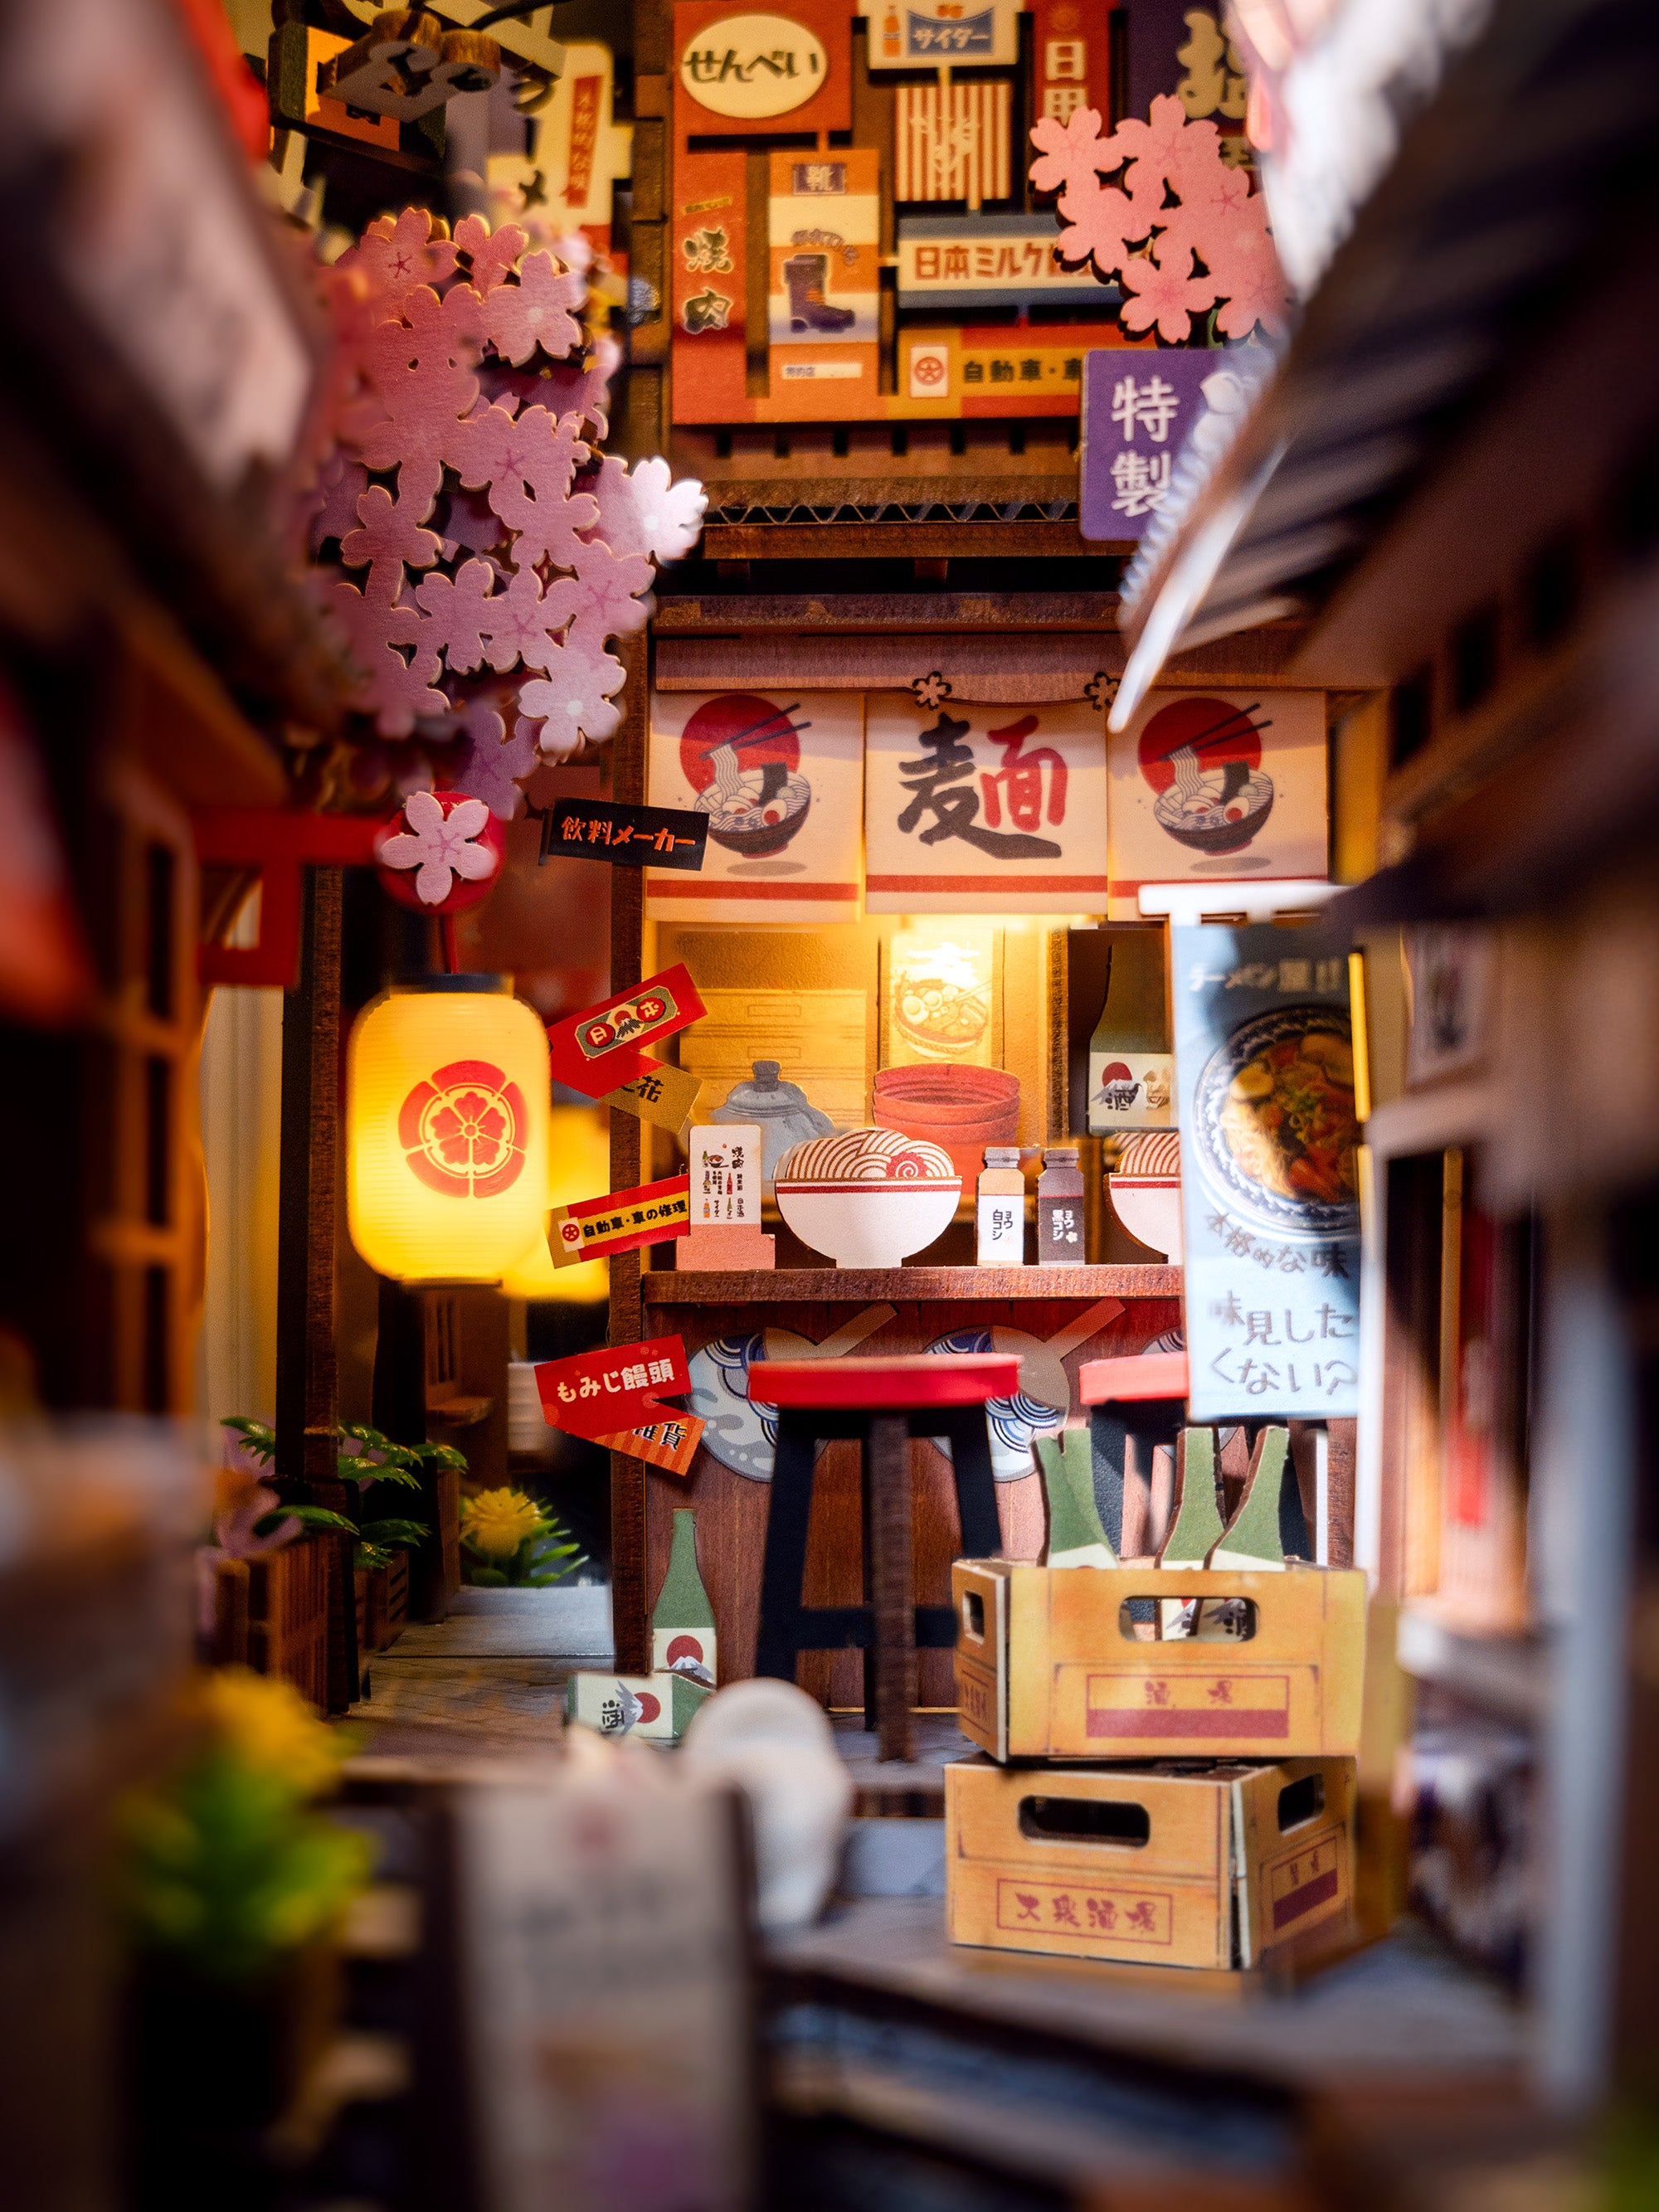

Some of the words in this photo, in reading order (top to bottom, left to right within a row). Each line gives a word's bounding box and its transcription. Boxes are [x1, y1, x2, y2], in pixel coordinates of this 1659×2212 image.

[914, 27, 990, 50] サイダー
[684, 49, 820, 85] せんべい
[1111, 375, 1179, 518] 特製
[561, 816, 696, 852] 飲料メーカー
[582, 1199, 688, 1238] 自動車・車の修理
[557, 1359, 676, 1403] もみじ饅頭
